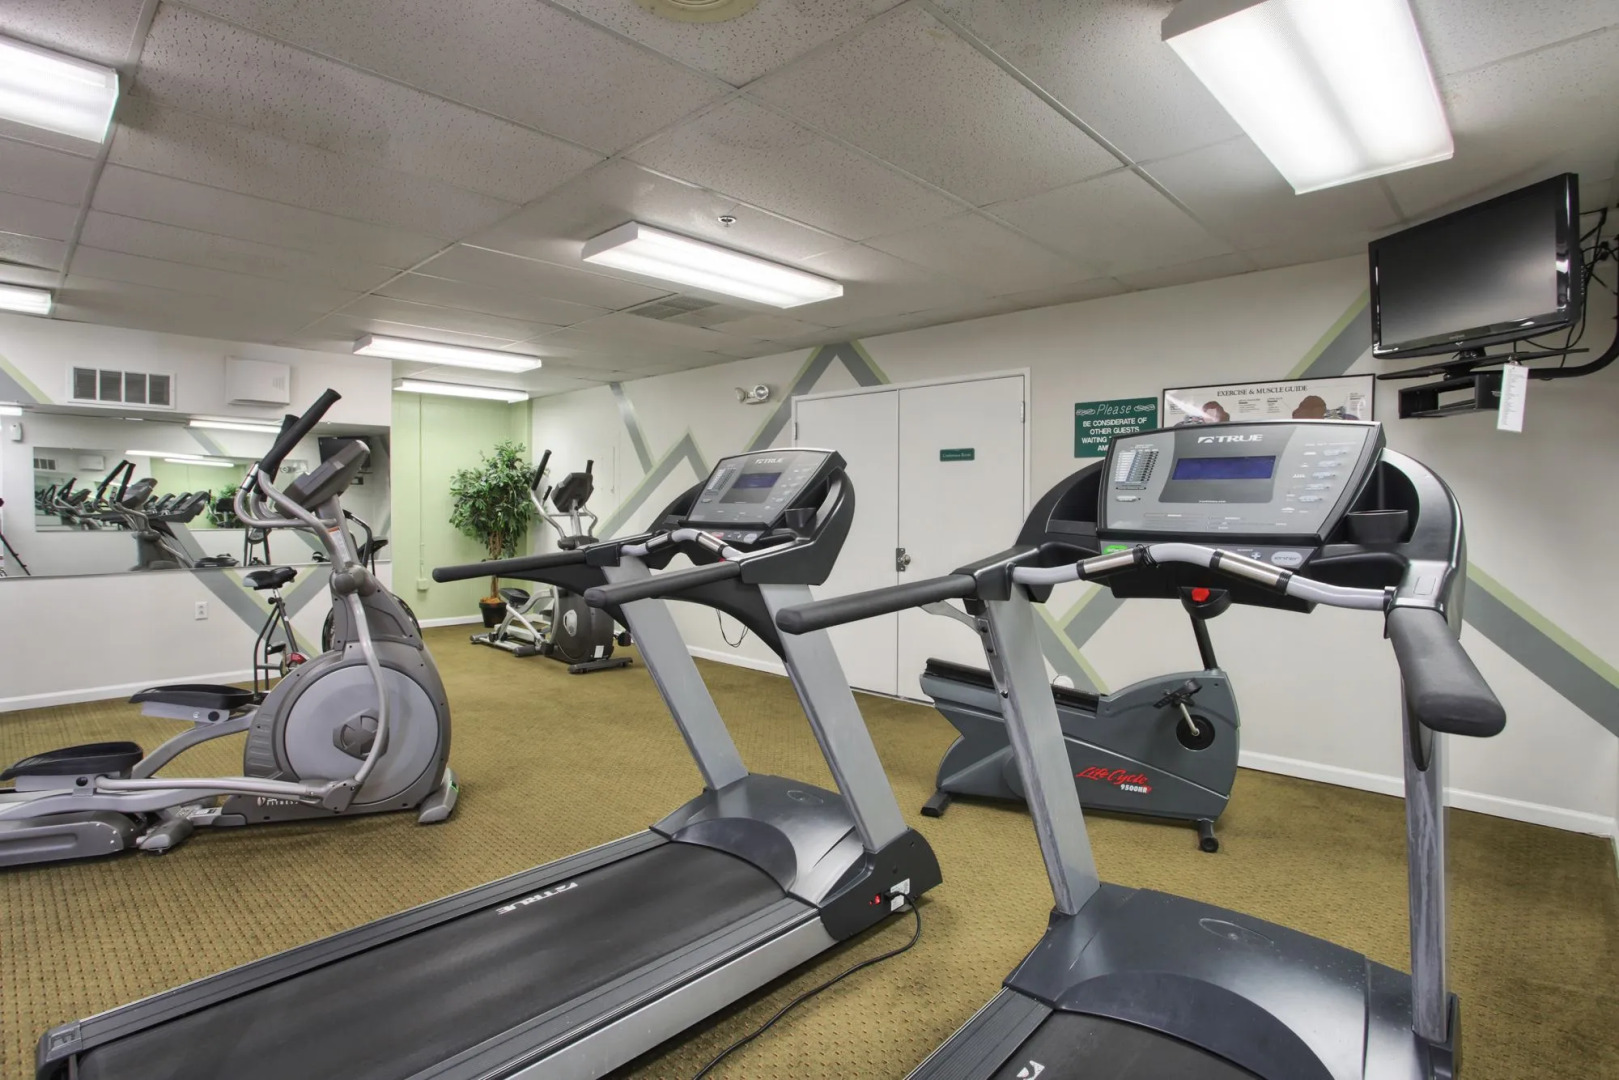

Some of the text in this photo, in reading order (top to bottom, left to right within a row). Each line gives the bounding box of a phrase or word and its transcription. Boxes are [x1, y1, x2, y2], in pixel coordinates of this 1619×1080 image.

[1217, 389, 1247, 397] EXERCISE
[1256, 386, 1284, 395] MUSCLE
[1285, 385, 1308, 393] GUIDE
[1097, 403, 1131, 415] Please
[1093, 417, 1136, 427] CONSIDERATE
[1137, 416, 1147, 424] OF
[1113, 426, 1140, 434] GUESTS
[1215, 434, 1263, 443] TRUE
[1120, 783, 1148, 794] 9500HR
